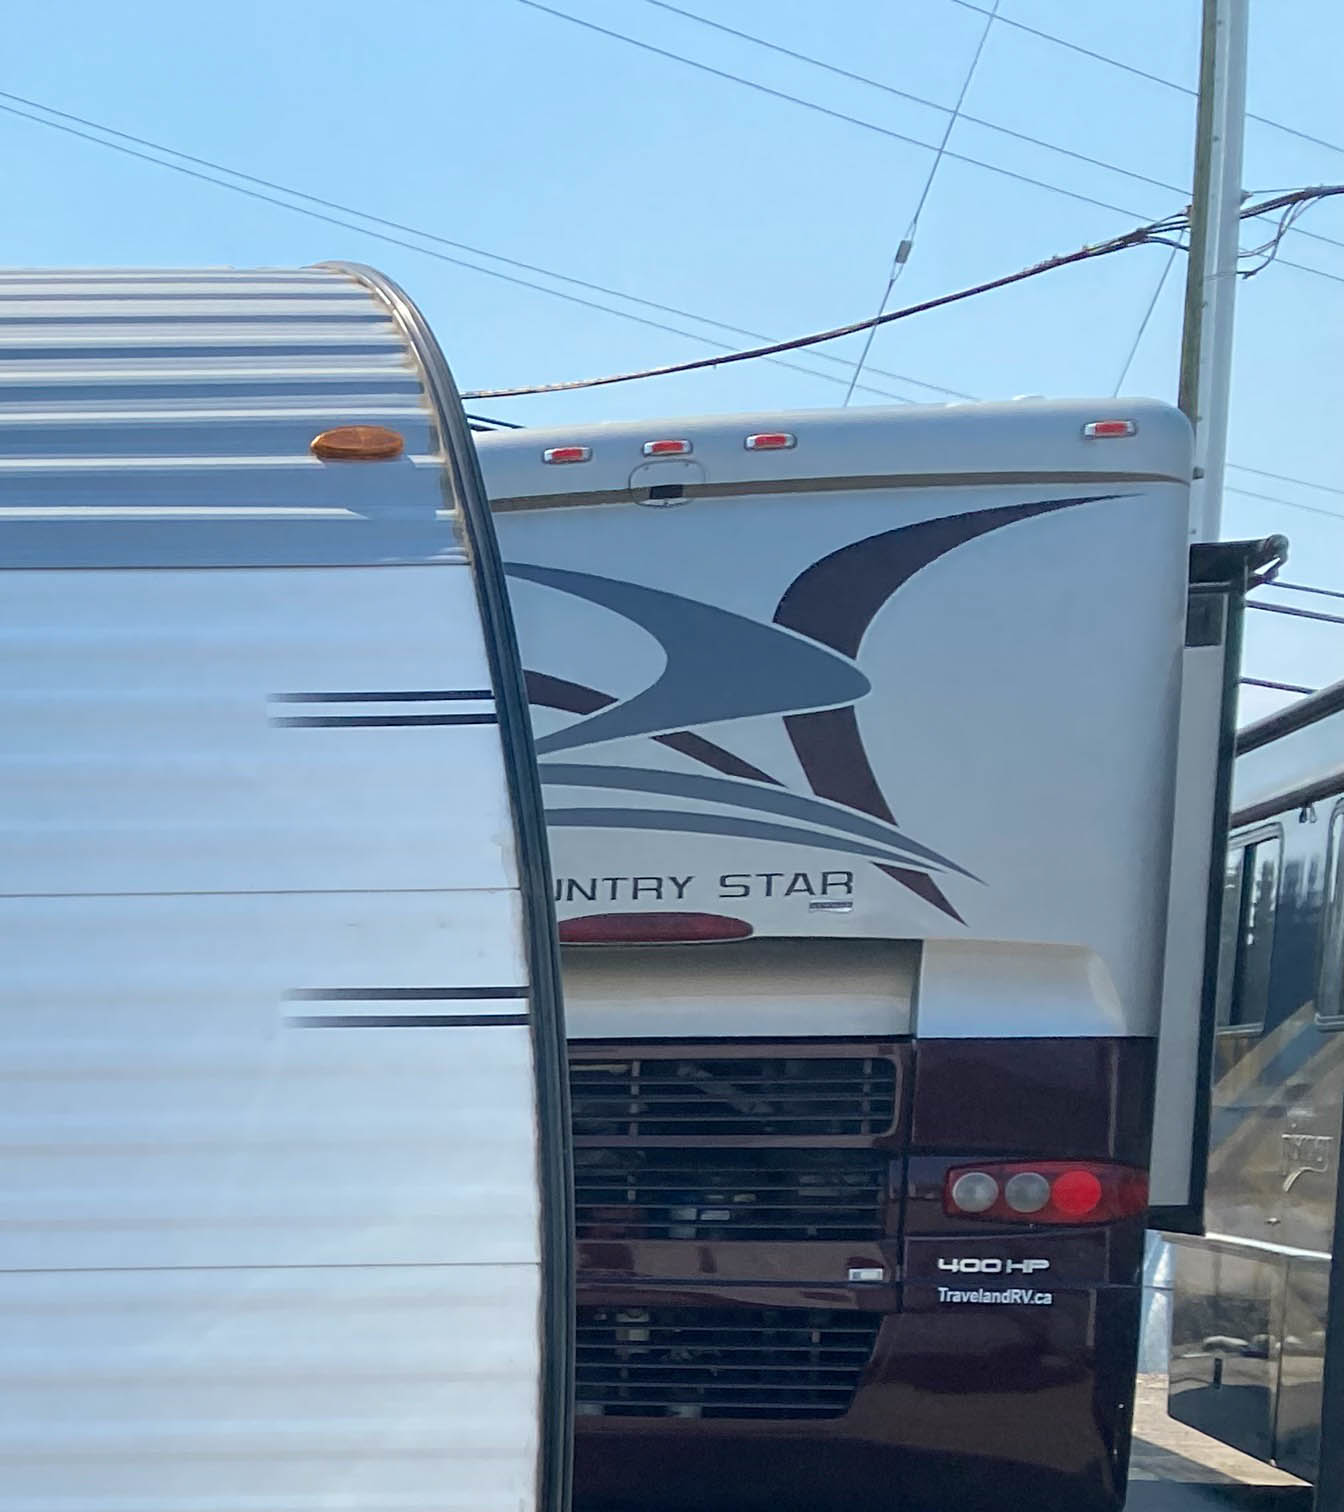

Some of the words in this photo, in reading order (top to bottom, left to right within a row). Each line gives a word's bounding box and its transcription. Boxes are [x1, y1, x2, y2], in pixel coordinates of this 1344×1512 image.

[718, 871, 854, 898] STAR
[937, 1258, 1003, 1273] 400
[1005, 1259, 1051, 1273] HP
[937, 1286, 1053, 1305] TravelandRV.ca
